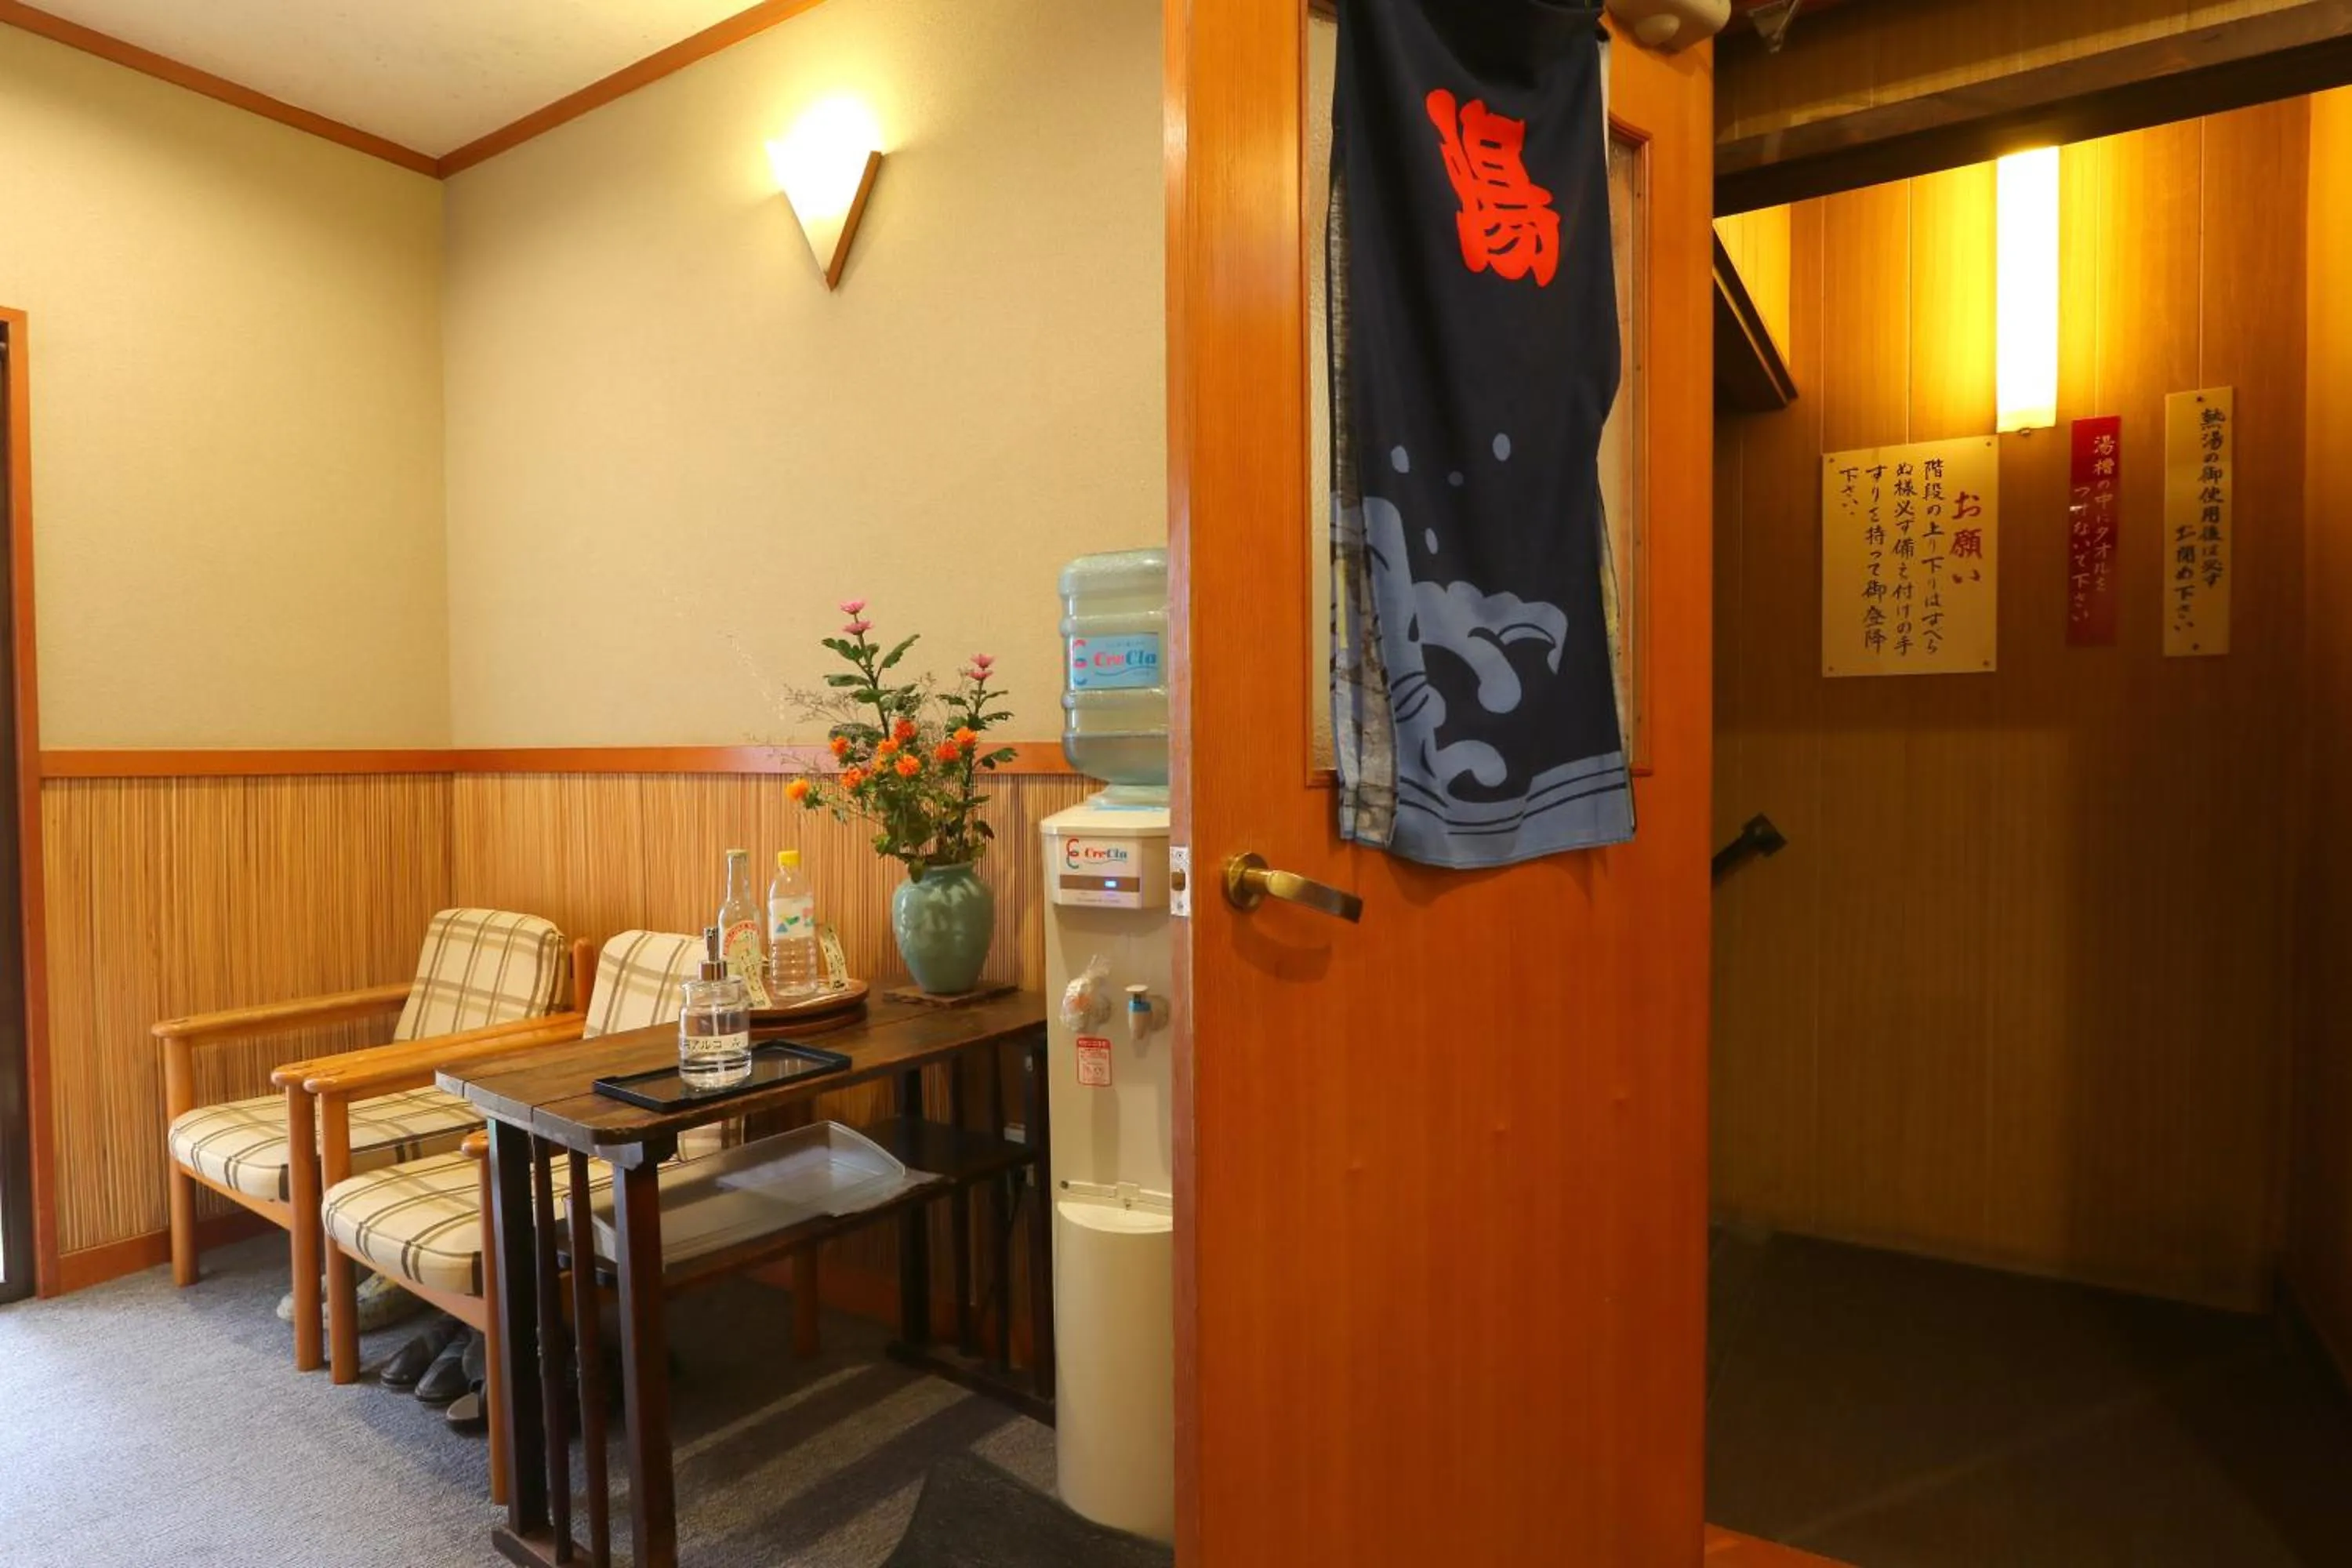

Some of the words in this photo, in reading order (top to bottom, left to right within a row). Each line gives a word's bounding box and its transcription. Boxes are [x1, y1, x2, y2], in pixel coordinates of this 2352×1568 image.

[1425, 89, 1561, 287] 湯
[1921, 459, 1945, 655] 階段の上り下りはすべら
[1949, 491, 1983, 585] お願い
